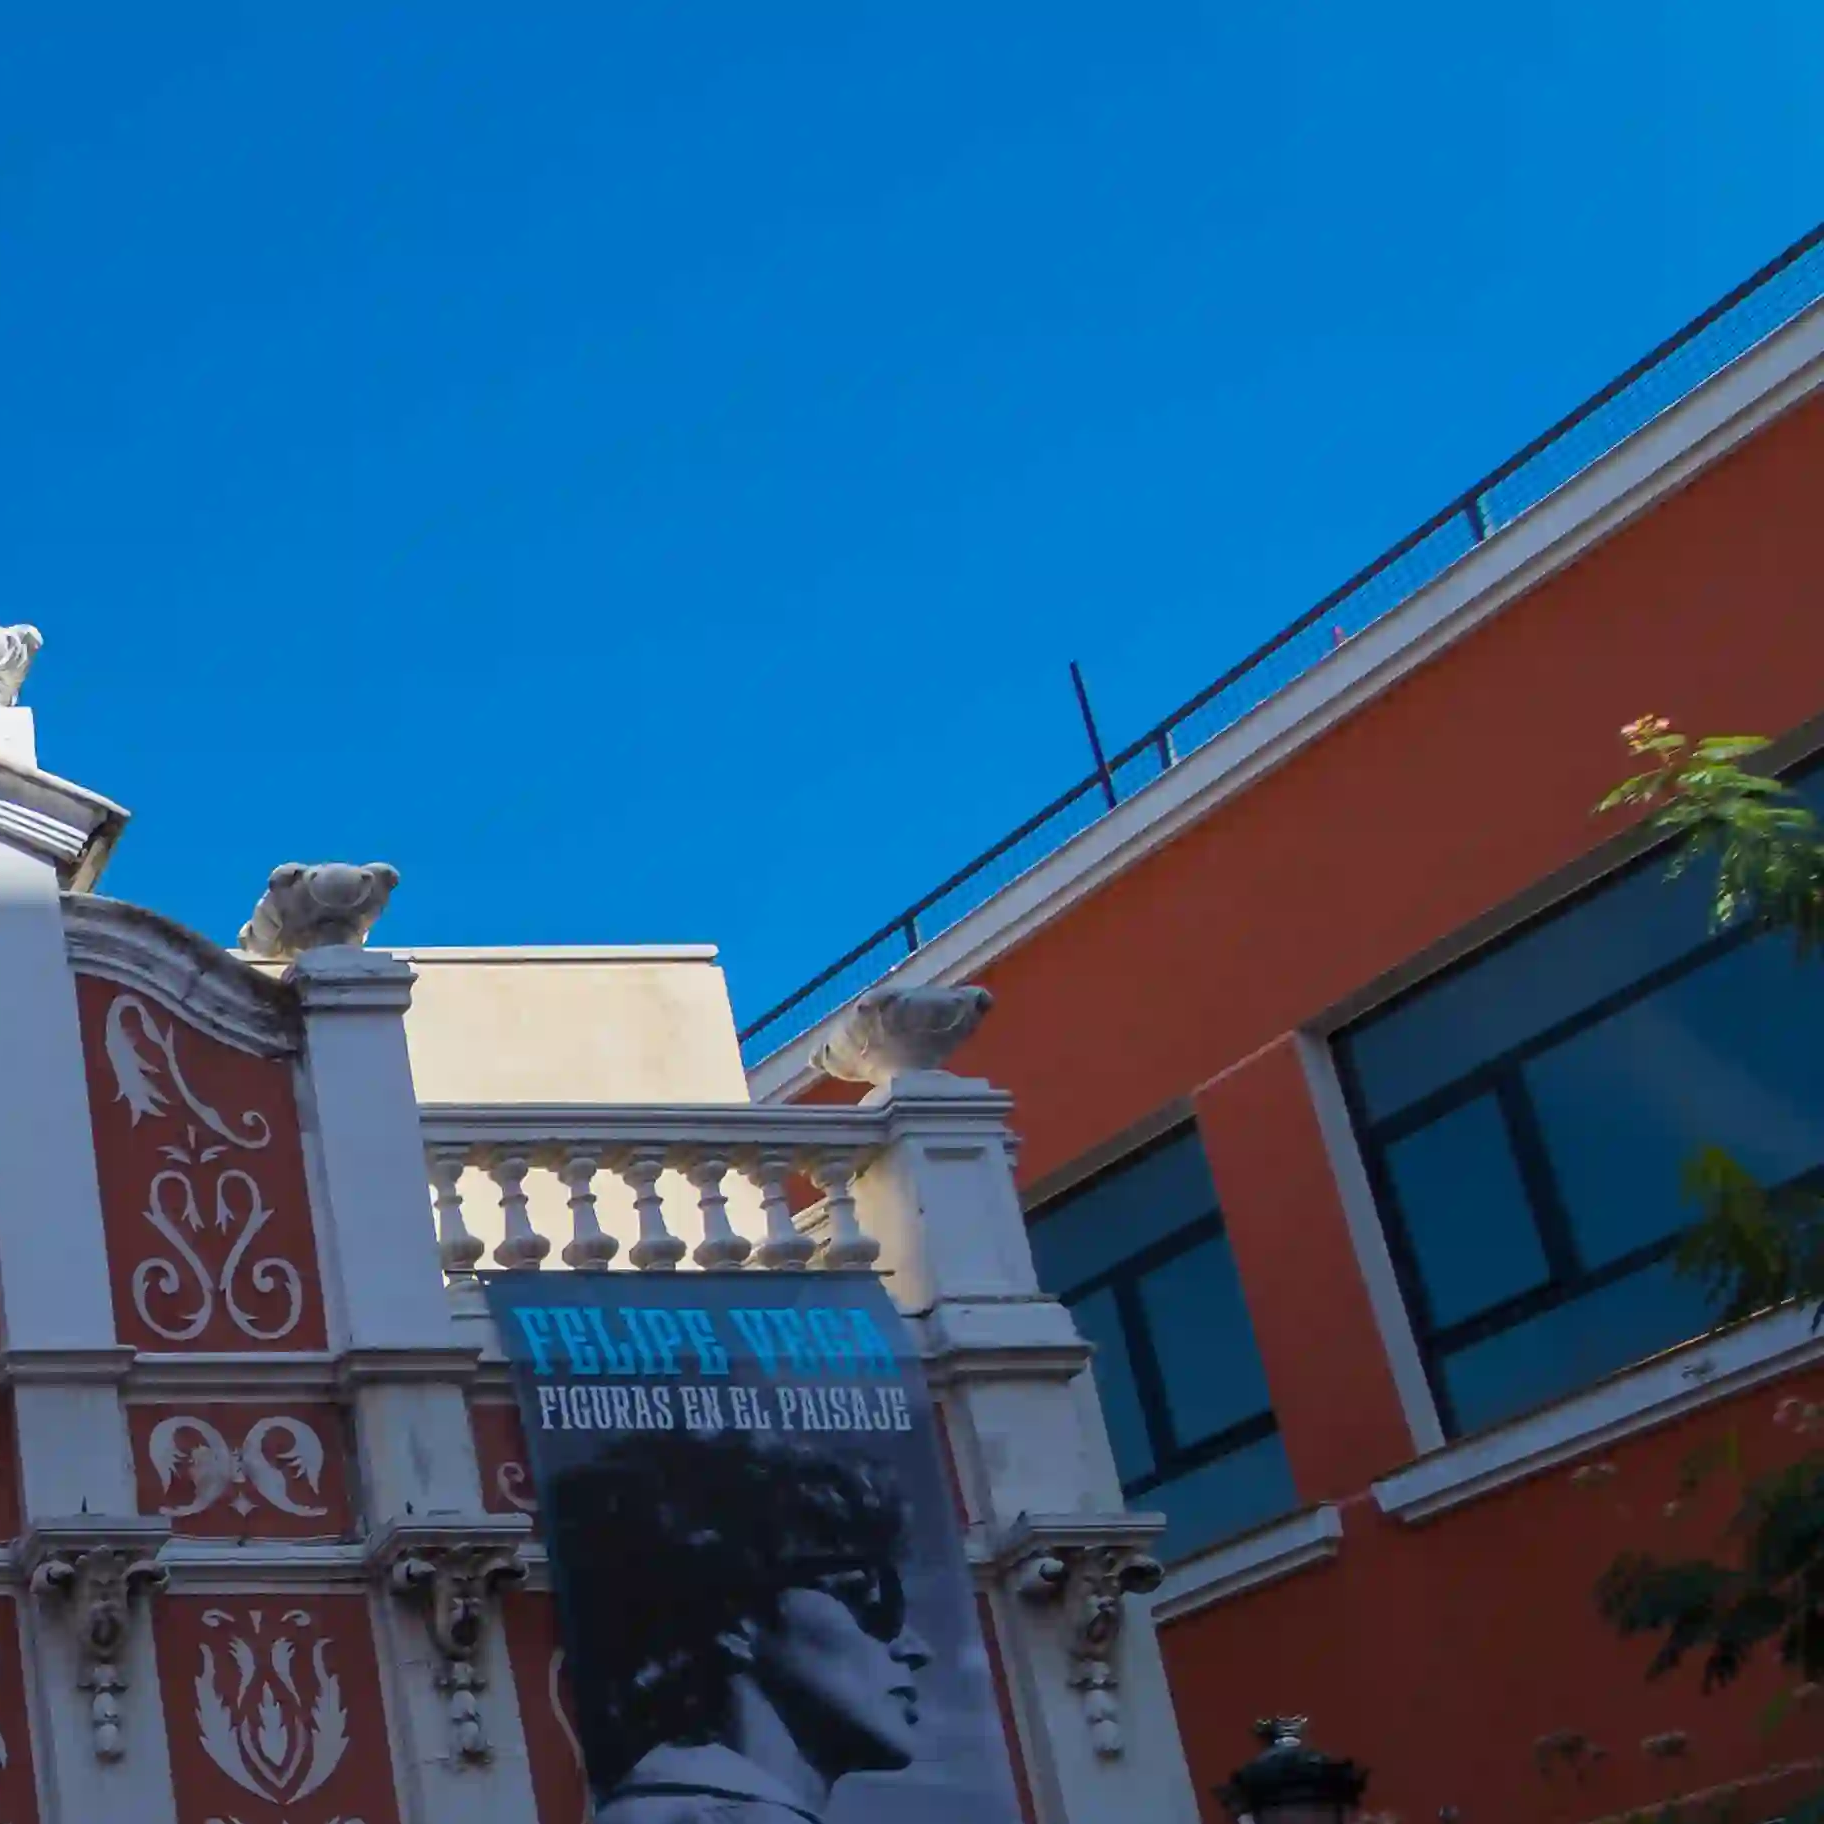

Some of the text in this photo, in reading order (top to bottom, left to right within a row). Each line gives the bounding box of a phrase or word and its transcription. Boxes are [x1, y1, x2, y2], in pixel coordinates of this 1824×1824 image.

[517, 1306, 902, 1379] FELIPE VEGA
[538, 1385, 912, 1431] FIGURAS EN EL PAISAJE
